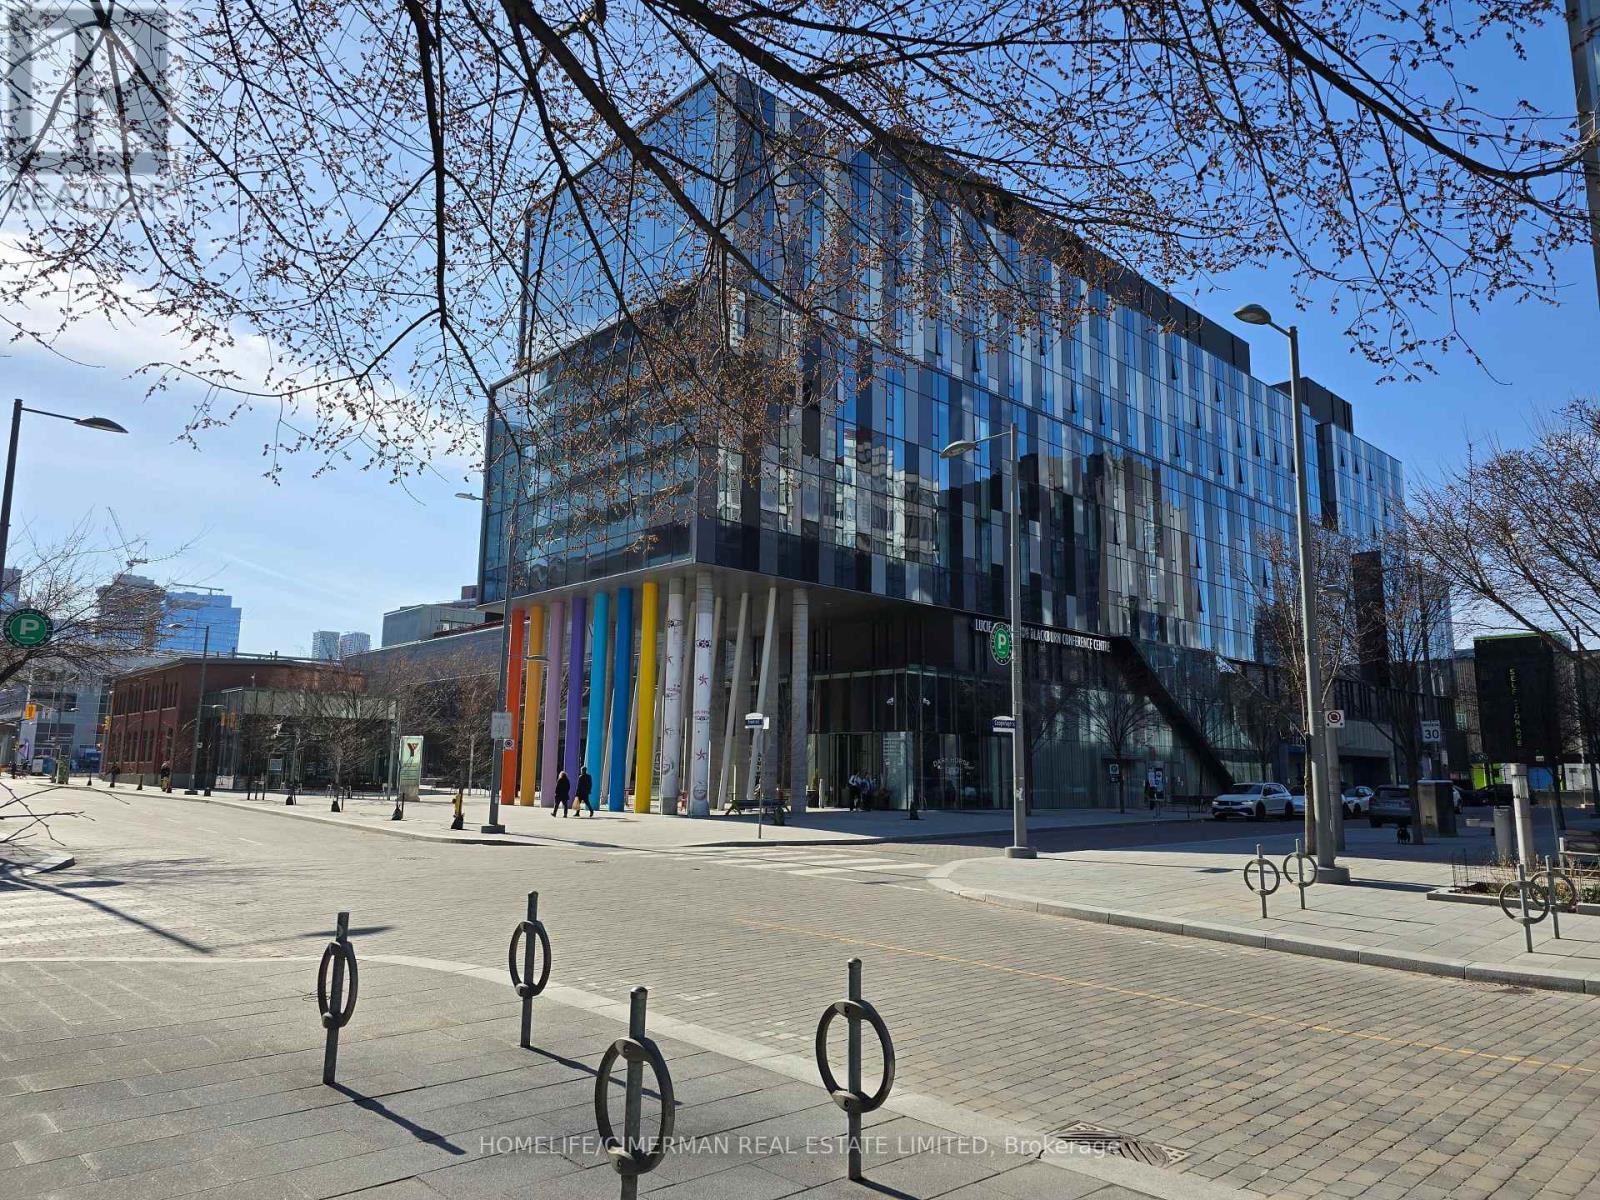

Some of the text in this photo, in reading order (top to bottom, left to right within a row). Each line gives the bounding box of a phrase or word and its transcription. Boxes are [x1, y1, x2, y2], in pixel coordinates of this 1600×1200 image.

[20, 618, 40, 635] P
[975, 618, 992, 633] LUCIE
[1030, 627, 1061, 645] BLACKBURN
[1062, 633, 1093, 650] CONFERENCE
[1093, 638, 1111, 653] CENTRE
[1425, 729, 1440, 739] 30
